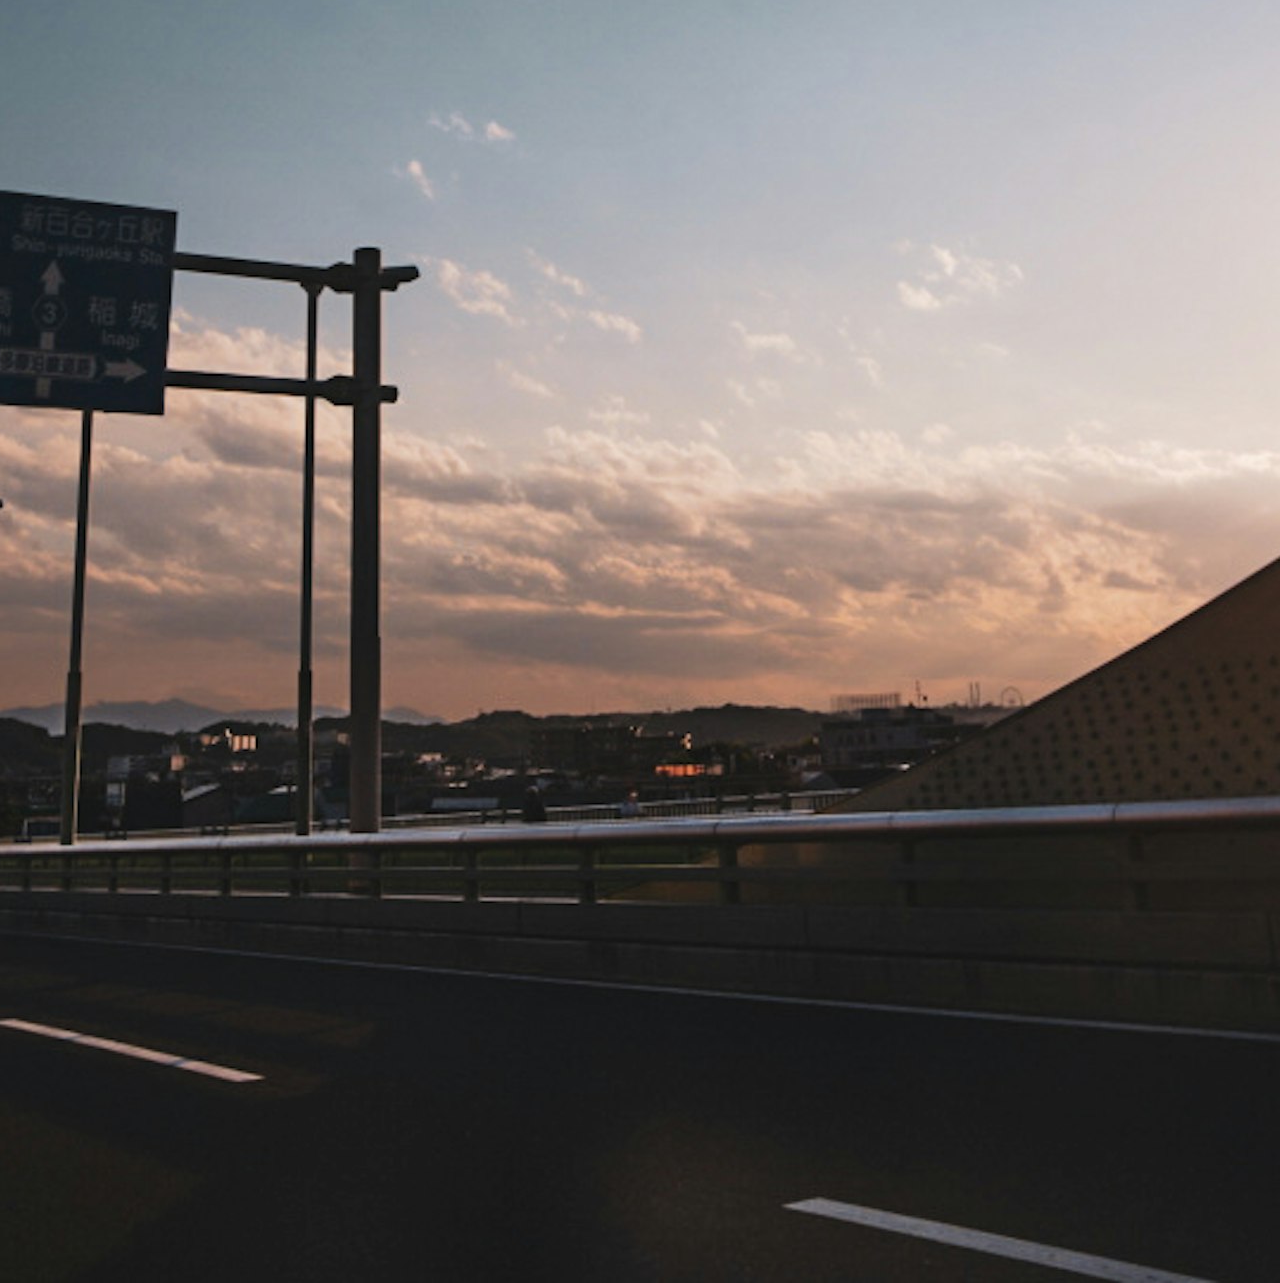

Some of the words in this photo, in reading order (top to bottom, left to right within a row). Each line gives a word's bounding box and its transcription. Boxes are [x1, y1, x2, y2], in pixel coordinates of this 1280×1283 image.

[42, 301, 58, 325] 3
[89, 296, 161, 331] 稲城
[101, 330, 141, 351] Inagi
